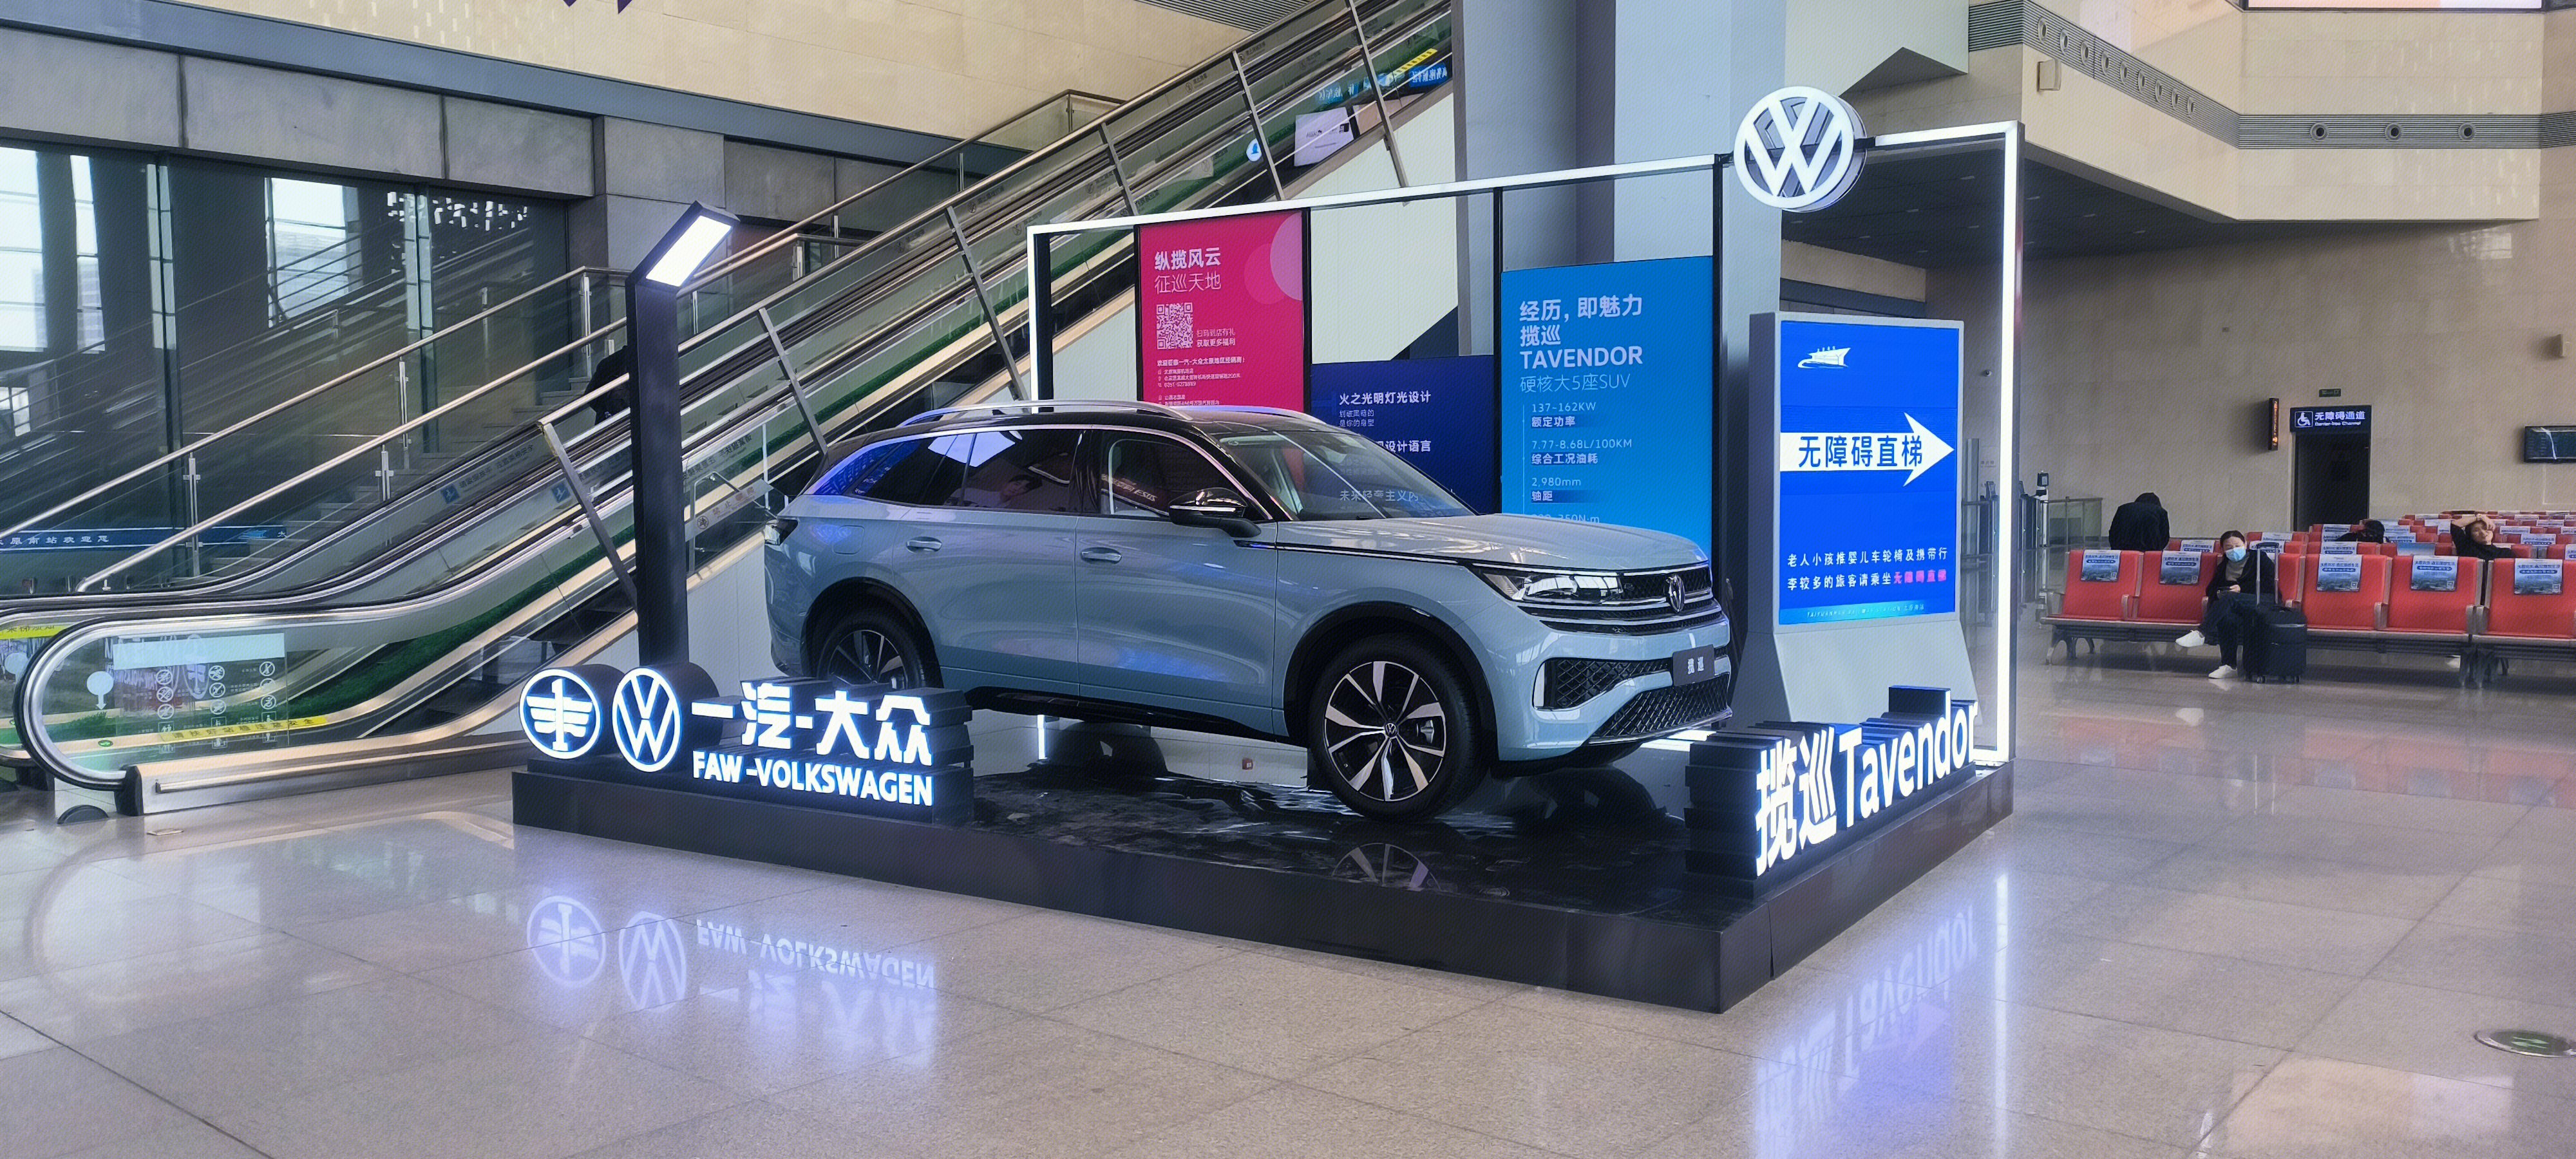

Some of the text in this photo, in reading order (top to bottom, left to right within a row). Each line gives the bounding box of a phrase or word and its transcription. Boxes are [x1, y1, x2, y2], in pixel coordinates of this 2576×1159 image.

[1155, 247, 1221, 271] 纵揽风云
[1155, 271, 1221, 294] 征巡天地
[1520, 324, 1561, 347] 揽巡
[1520, 346, 1643, 370] TAVENDOR
[1520, 373, 1631, 393] 硬核大5座SUV
[1339, 390, 1432, 406] 火之光明灯光设计
[1531, 416, 1575, 428] 额定功率
[2315, 411, 2365, 421] 无障碍通道
[1532, 438, 1632, 450] 7.77-8.68L/100KM
[1799, 435, 1924, 468] 无障碍直梯
[1531, 453, 1598, 464] 综合工况油耗
[1532, 477, 1581, 487] 2,980mm
[1531, 491, 1553, 502] 轴距
[1787, 547, 1947, 567] 老人小孩推婴儿车轮椅及携带行
[692, 681, 933, 766] 一汽-大众
[1756, 689, 1978, 877] 揽巡 Tavendor
